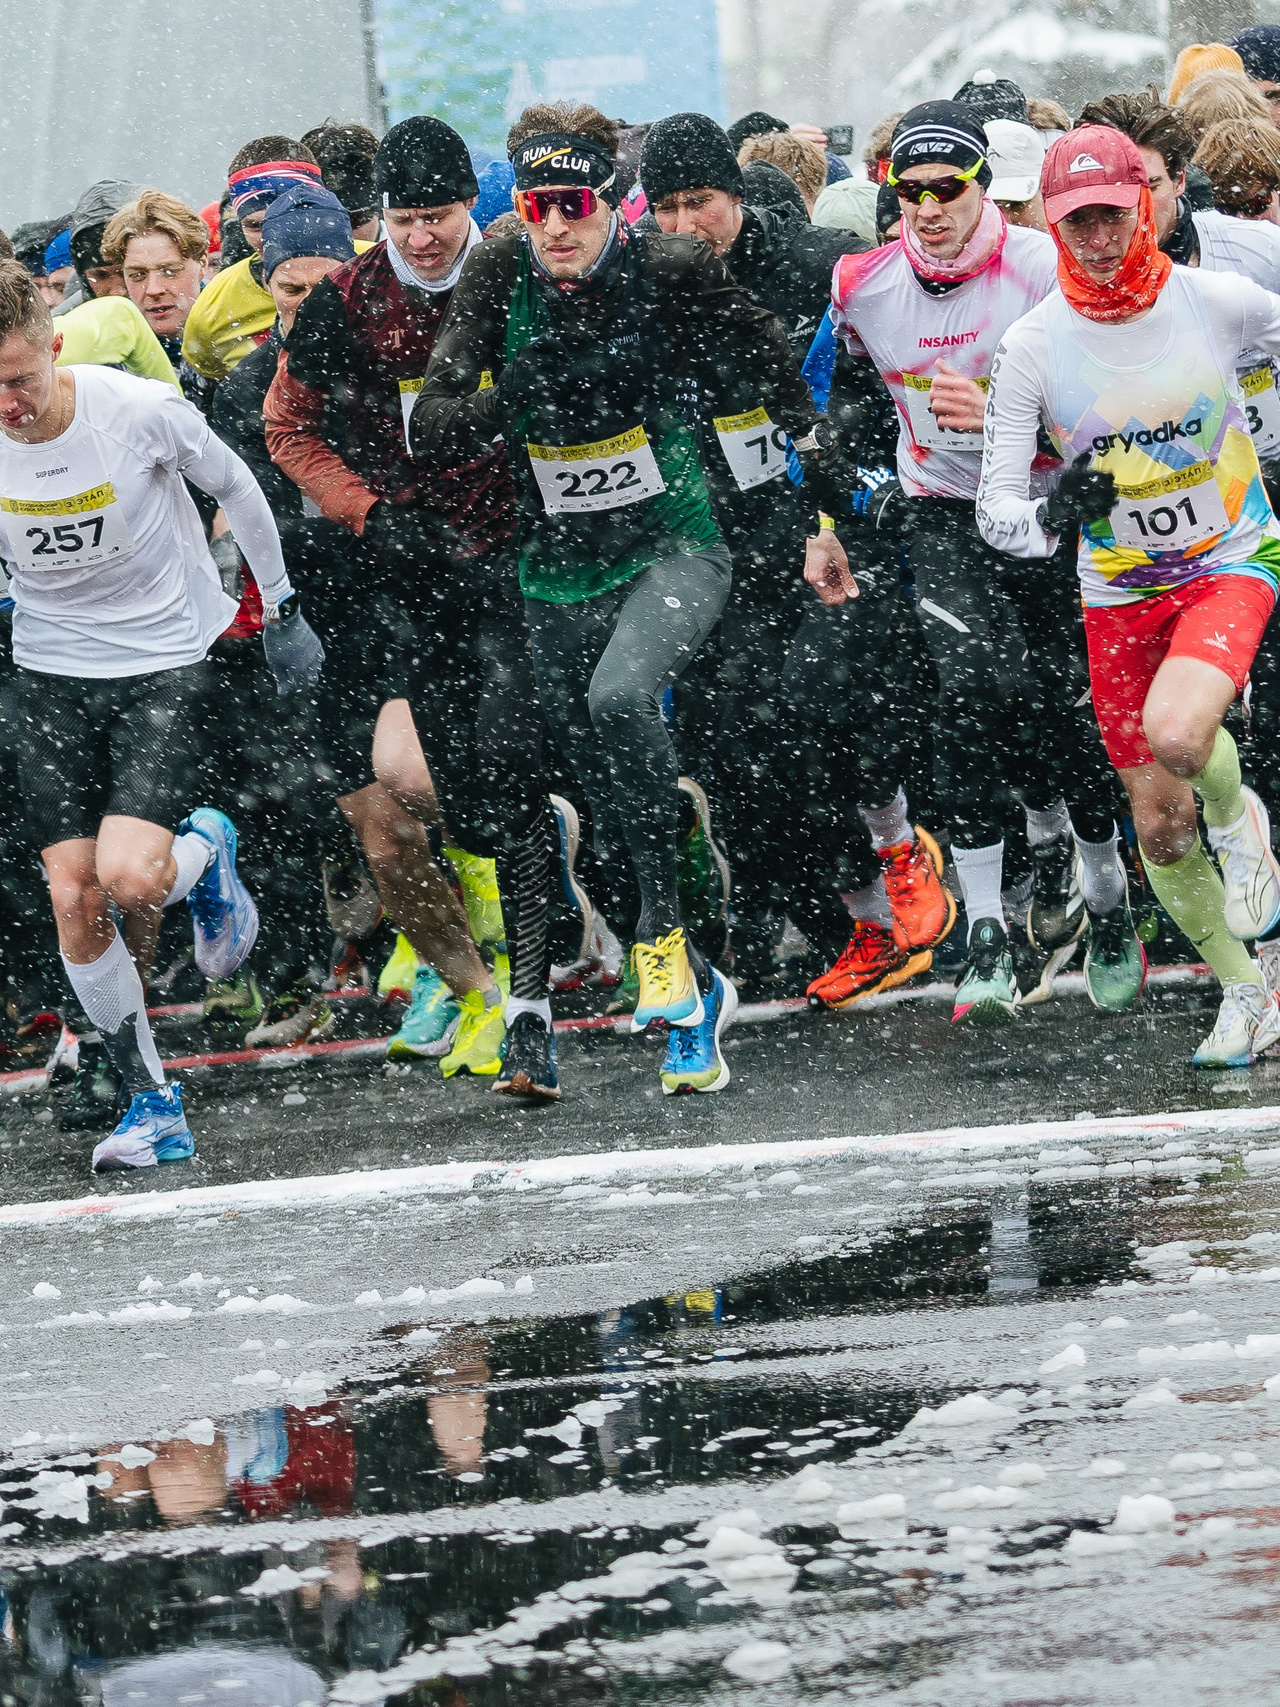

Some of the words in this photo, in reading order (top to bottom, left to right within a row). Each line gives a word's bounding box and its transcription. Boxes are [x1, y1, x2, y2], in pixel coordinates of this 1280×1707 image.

[522, 146, 552, 165] RUN
[551, 156, 591, 173] CLUB
[918, 331, 980, 348] INSANITY
[1092, 418, 1202, 457] gryadka
[35, 466, 69, 478] SUPERDRY
[555, 460, 642, 498] 222
[1174, 467, 1201, 484] ЭТАП
[76, 489, 104, 505] ЭТАП
[1127, 496, 1198, 537] 101
[25, 515, 104, 556] 257
